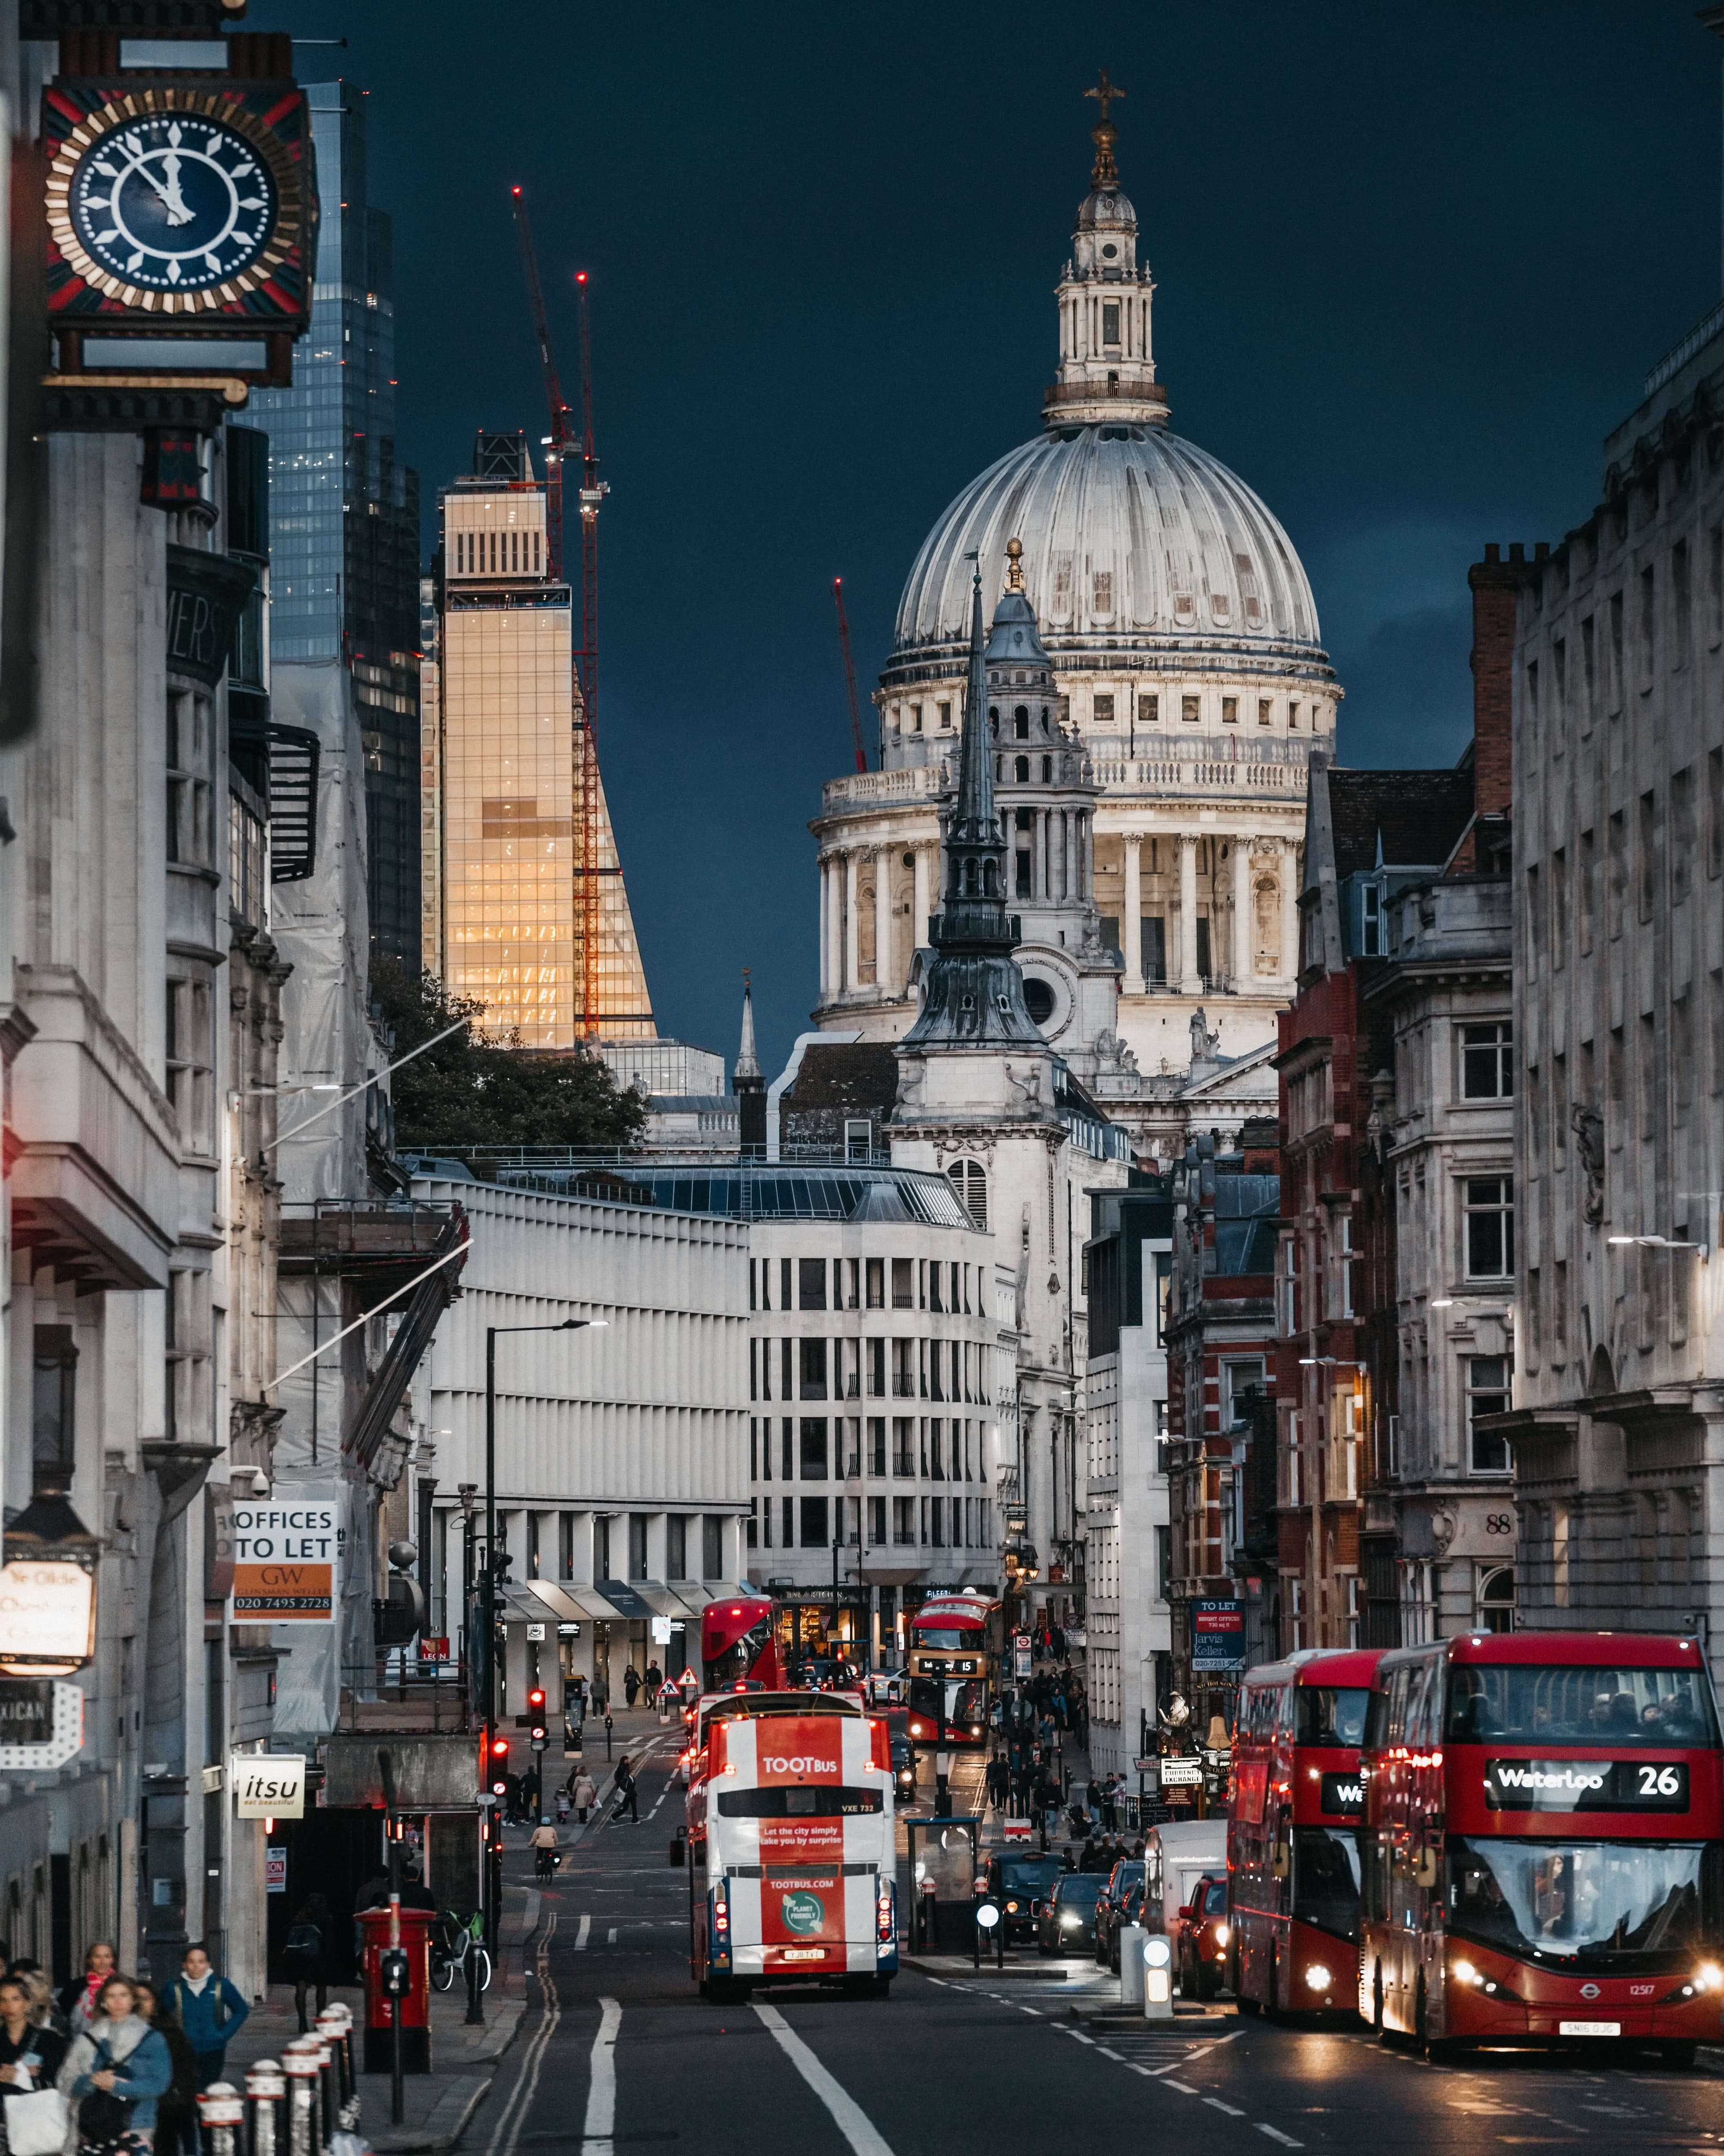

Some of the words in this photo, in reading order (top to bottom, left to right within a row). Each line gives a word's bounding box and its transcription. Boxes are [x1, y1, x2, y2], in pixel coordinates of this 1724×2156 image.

[236, 1512, 332, 1529] OFFICES
[1487, 1514, 1511, 1534] 88
[236, 1538, 274, 1558] TO
[286, 1539, 332, 1558] LET
[260, 1566, 304, 1585] GW
[236, 1598, 261, 1608] 020
[266, 1598, 295, 1608] 7495
[300, 1598, 330, 1608] 2728
[1202, 1602, 1216, 1610] TO
[1218, 1602, 1236, 1610] LET
[1194, 1633, 1223, 1645] Jarvis
[1194, 1645, 1224, 1656] Keller
[963, 1662, 971, 1671] 15
[1201, 1762, 1212, 1772] THE
[1498, 1768, 1603, 1789] Waterloo
[1639, 1766, 1679, 1795] 26
[246, 1775, 297, 1798] itsu
[794, 1827, 809, 1836] city
[811, 1826, 837, 1835] simply
[797, 1837, 807, 1845] by
[809, 1837, 841, 1846] surprise
[770, 1880, 834, 1889] TOOTBUS.COM
